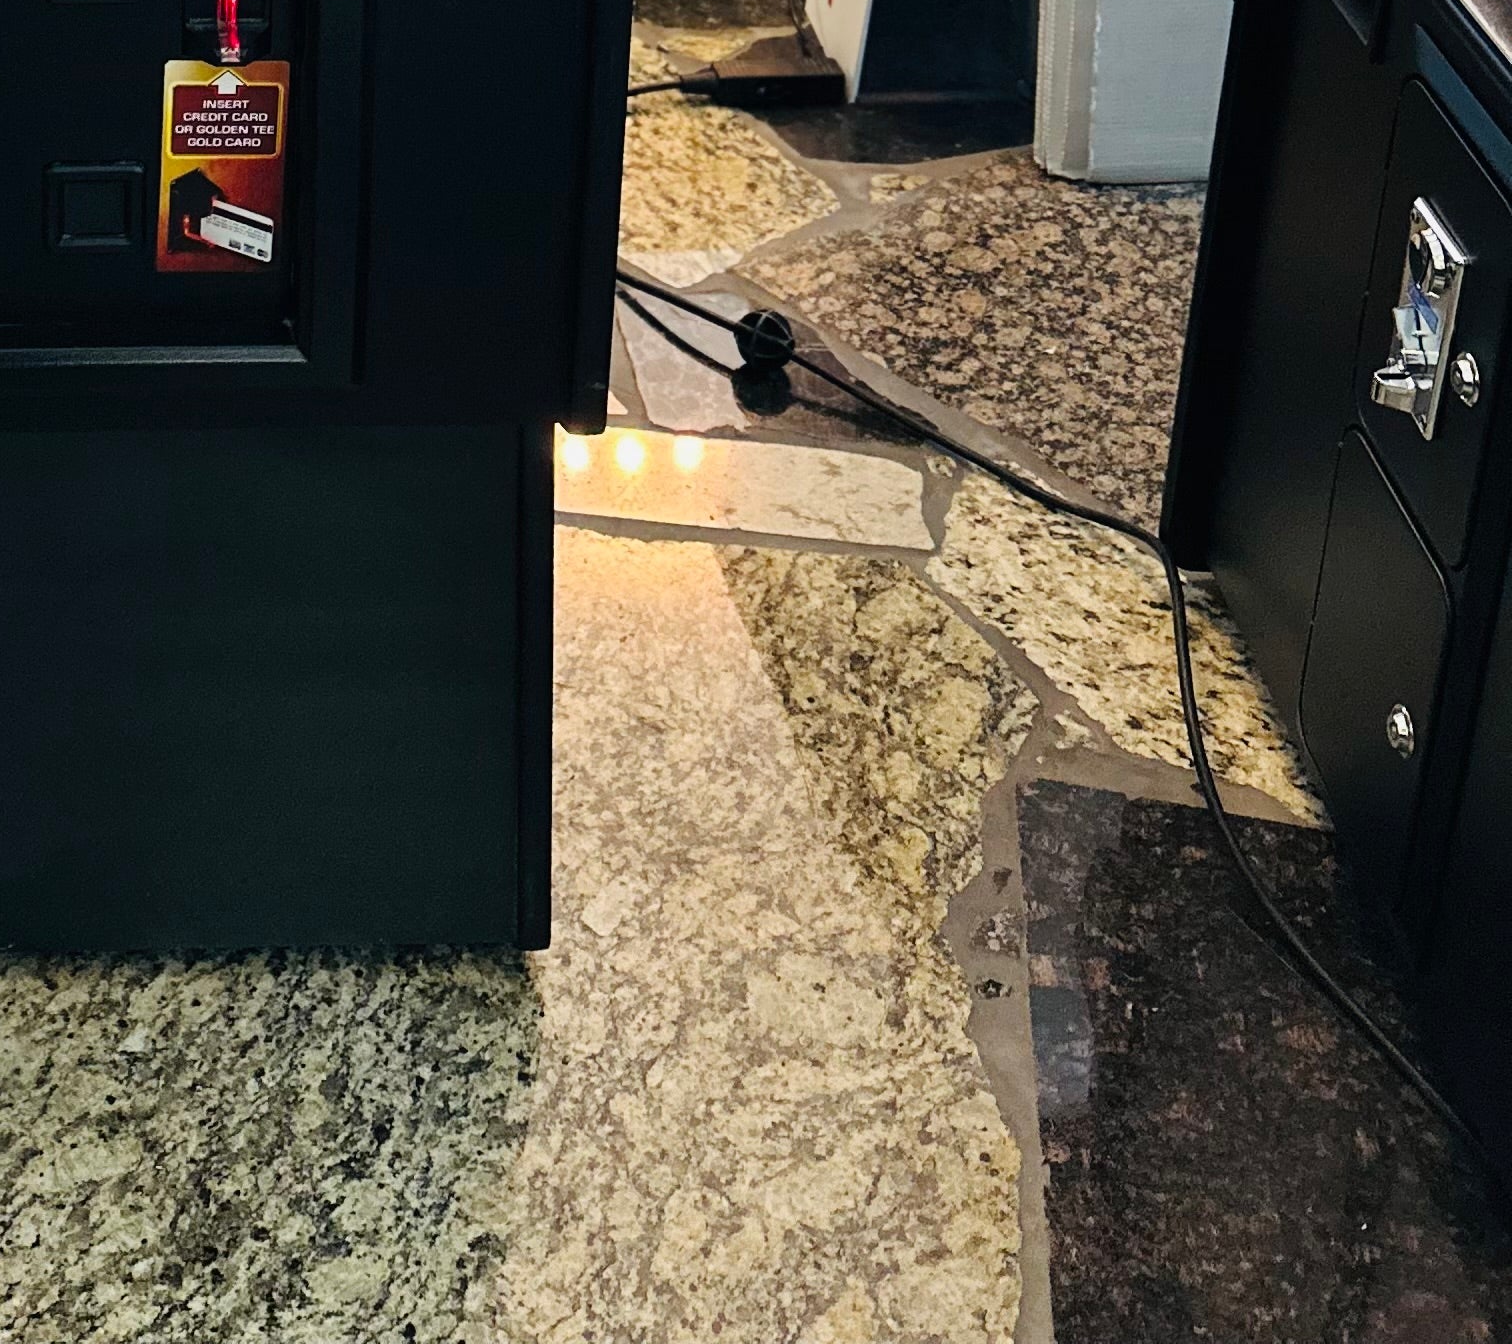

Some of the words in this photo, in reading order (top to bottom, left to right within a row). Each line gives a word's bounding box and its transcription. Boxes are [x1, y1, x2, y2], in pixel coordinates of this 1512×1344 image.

[202, 99, 250, 109] INSERT
[182, 112, 230, 122] CREDIT
[232, 112, 269, 122] CARD
[174, 124, 194, 135] OR
[195, 124, 249, 135] GOLDEN
[251, 124, 275, 135] TEE
[187, 137, 223, 147] GOLD
[224, 137, 262, 147] CARD
